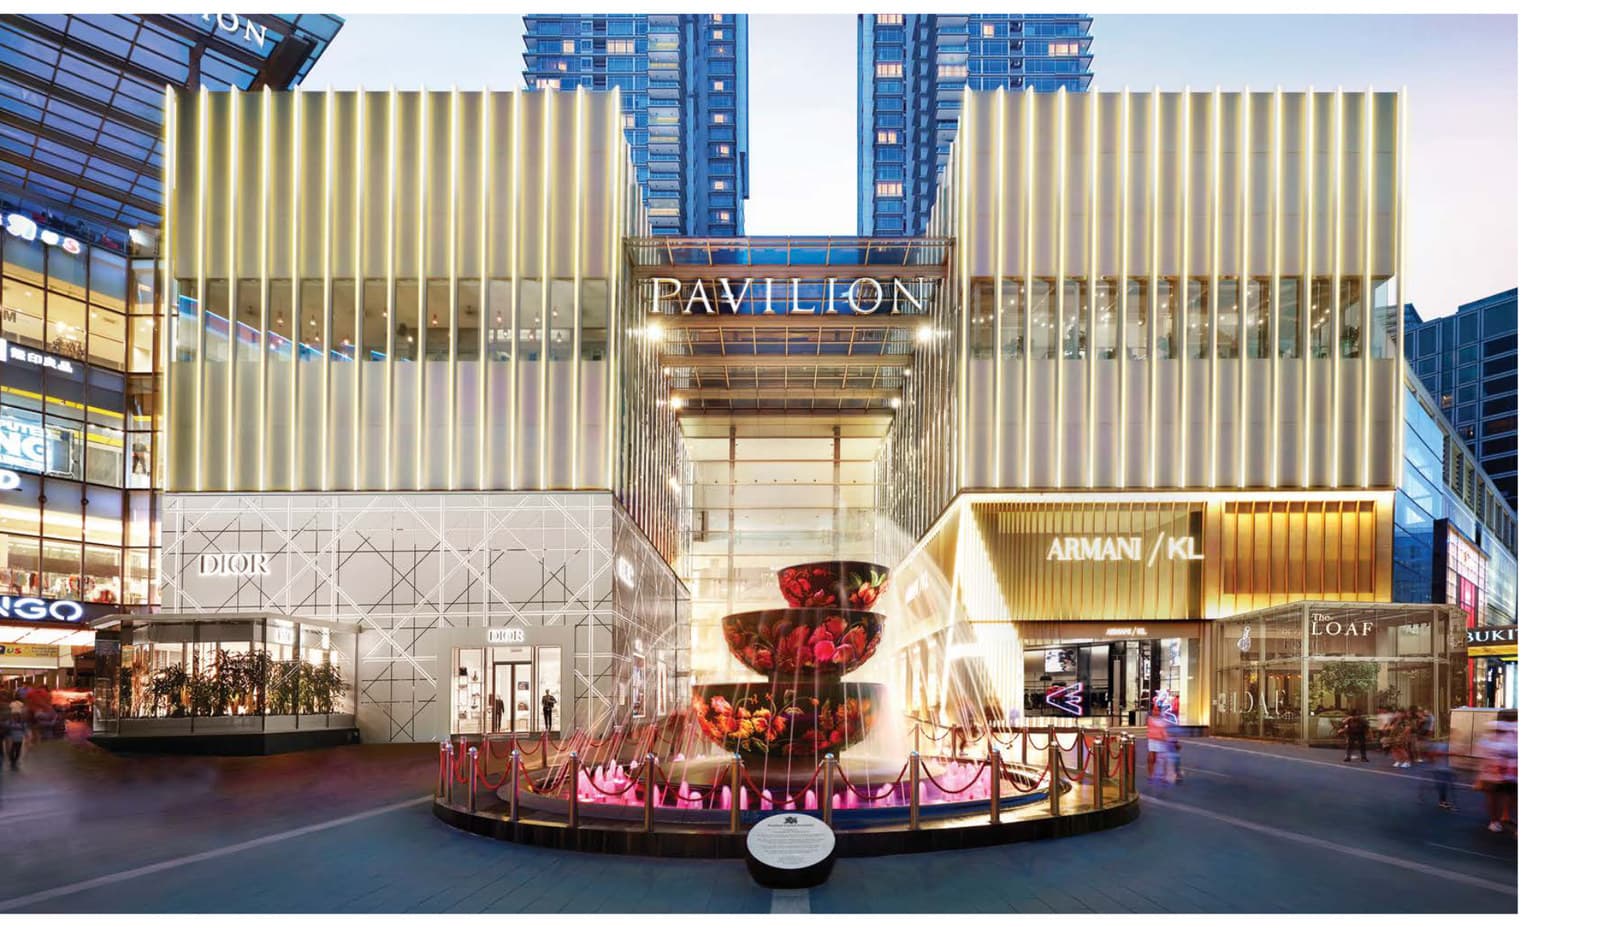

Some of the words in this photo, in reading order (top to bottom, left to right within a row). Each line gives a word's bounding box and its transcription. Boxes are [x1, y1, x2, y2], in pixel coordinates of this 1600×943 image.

[650, 276, 925, 315] PAVILION
[1047, 536, 1142, 561] ARMANI
[199, 552, 271, 576] DIOR
[1311, 613, 1333, 622] The
[488, 629, 524, 642] DIOR
[1312, 621, 1374, 636] LOAF
[1467, 629, 1518, 642] BUKI
